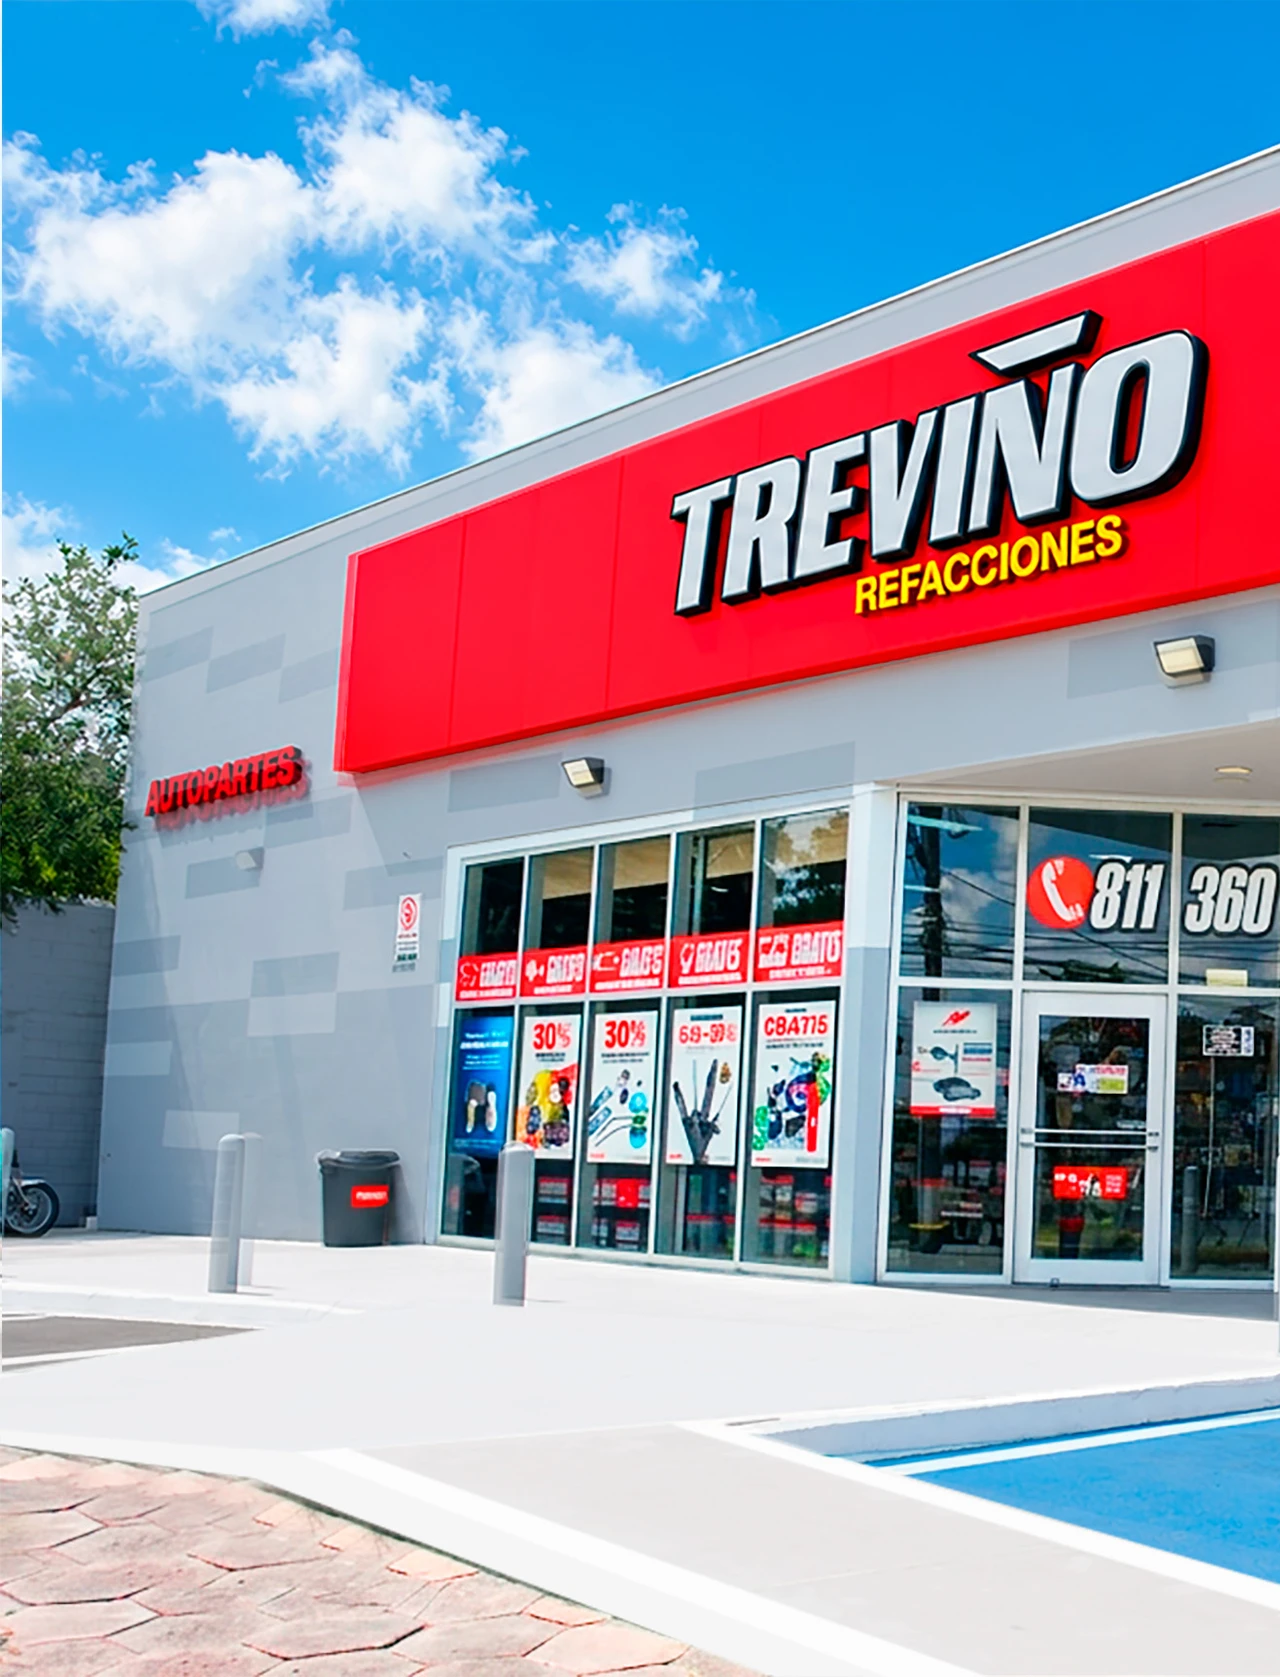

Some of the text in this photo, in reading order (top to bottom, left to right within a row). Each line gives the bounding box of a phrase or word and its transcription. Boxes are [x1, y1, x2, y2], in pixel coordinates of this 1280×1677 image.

[670, 309, 1209, 616] TREVIÑO
[854, 514, 1124, 615] REFACCIONES
[144, 745, 303, 817] AUTOPARTES
[1089, 861, 1166, 930] 811
[1183, 864, 1278, 935] 360
